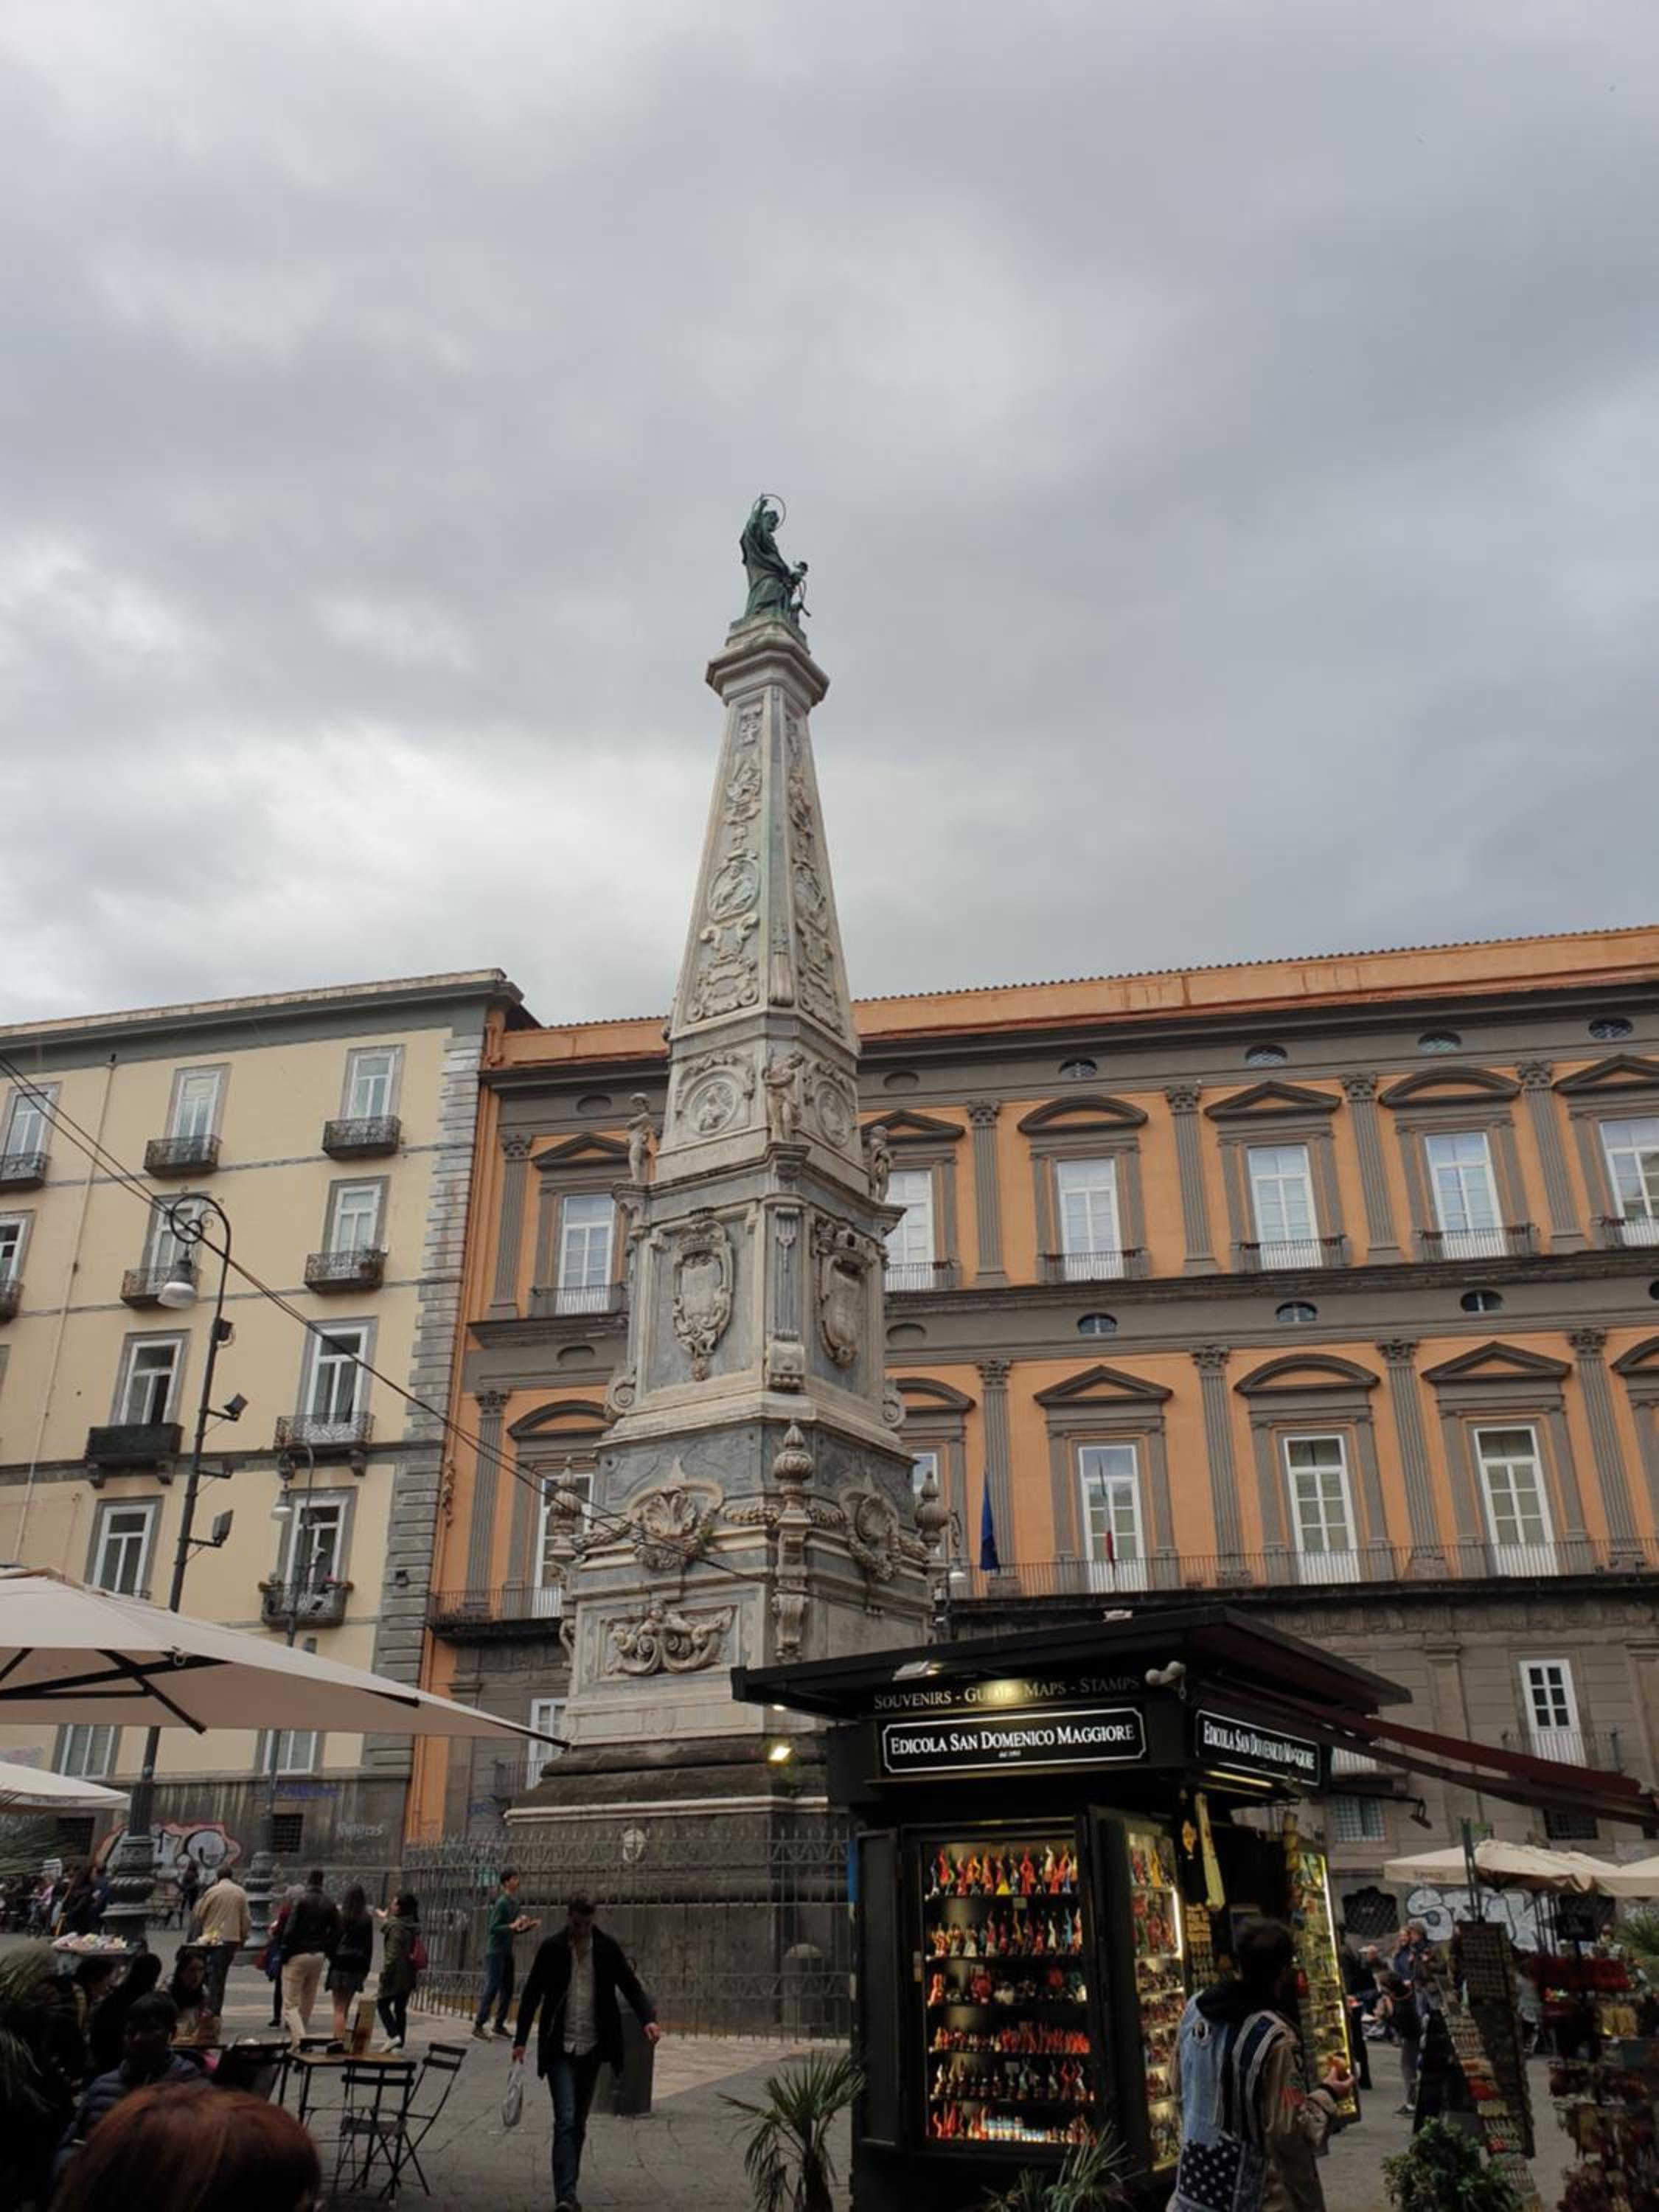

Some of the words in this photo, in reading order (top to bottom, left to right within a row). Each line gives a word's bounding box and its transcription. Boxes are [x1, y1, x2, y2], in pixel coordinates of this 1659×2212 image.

[874, 1690, 952, 1710] SOUVENIRS
[1024, 1681, 1066, 1697] MAPS
[1079, 1676, 1140, 1694] STAMPS
[891, 1736, 947, 1754] EDICOLA
[950, 1733, 978, 1751] SAN
[981, 1730, 1054, 1750] DOMENICO
[1057, 1725, 1135, 1745] MAGGIORE
